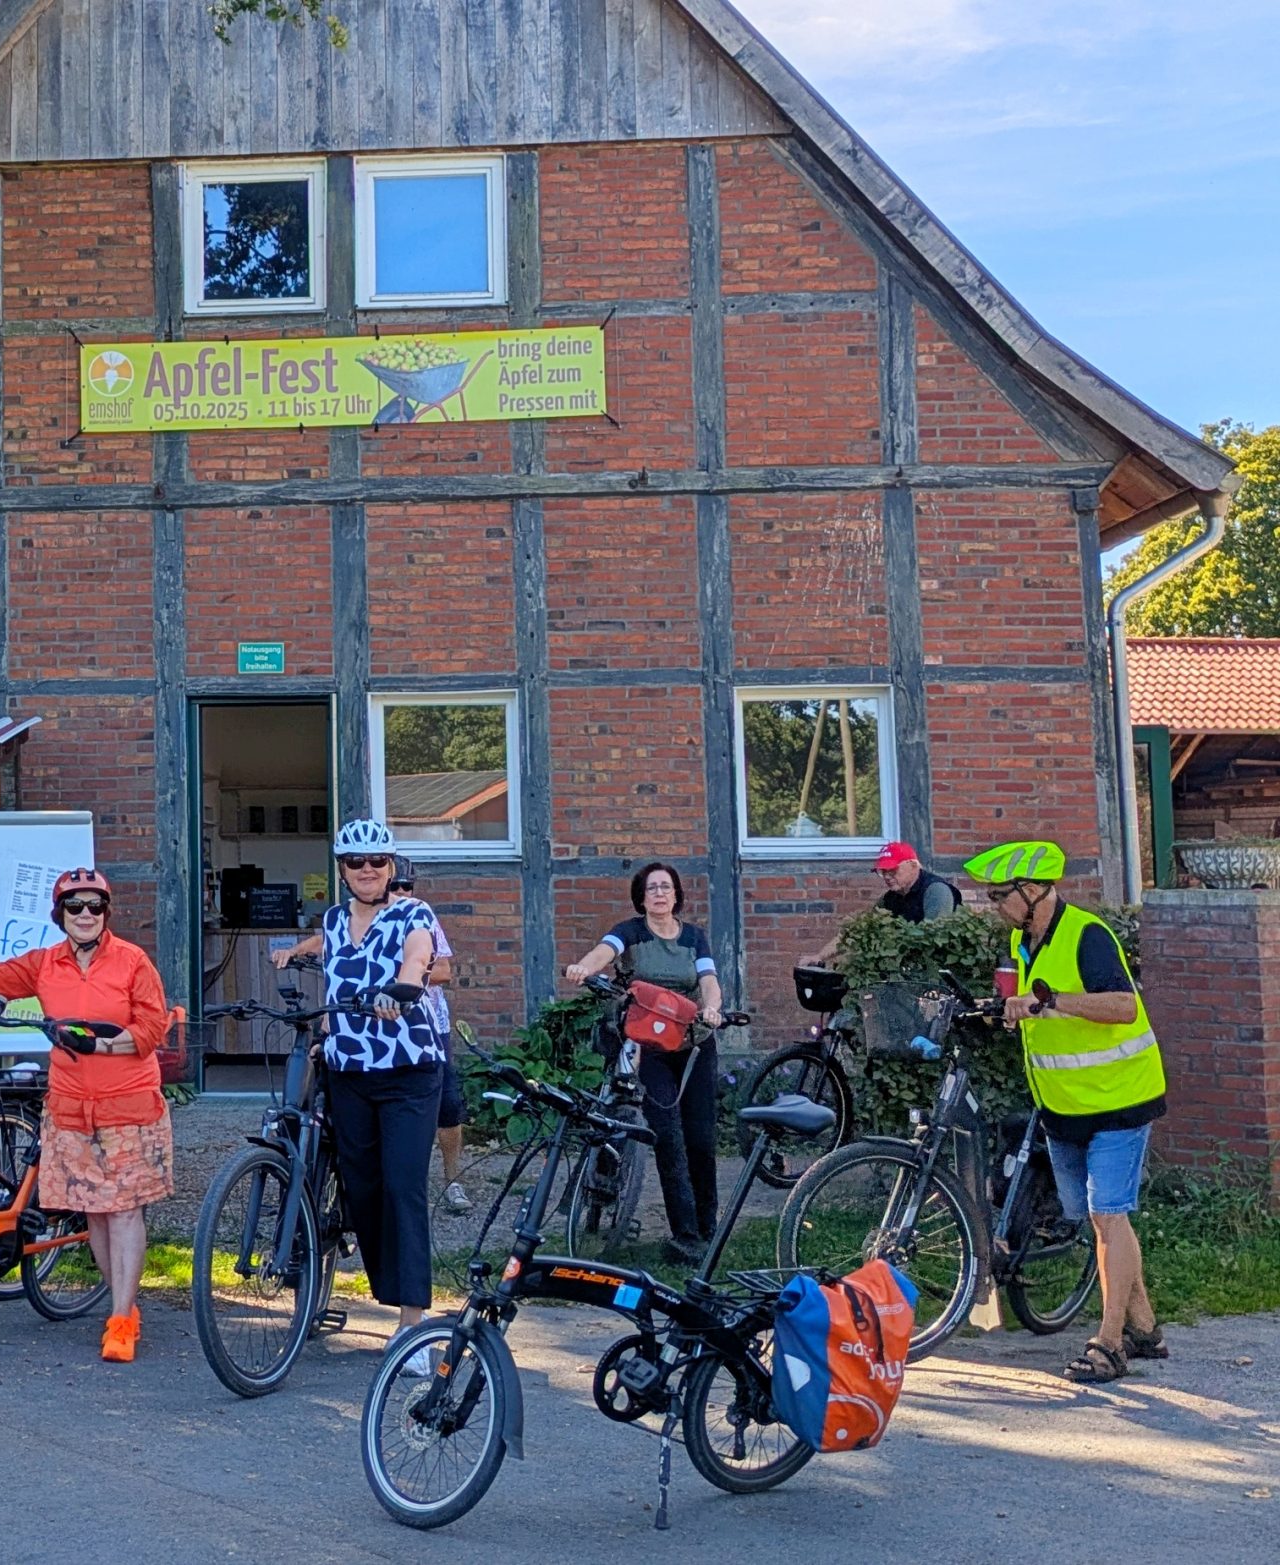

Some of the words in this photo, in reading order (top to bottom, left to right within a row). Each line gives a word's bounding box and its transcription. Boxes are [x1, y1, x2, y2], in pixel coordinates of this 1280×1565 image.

[498, 337, 541, 361] bring
[547, 335, 592, 356] deine
[143, 347, 338, 410] Apfel-Fest
[499, 361, 542, 390] Äpfel
[547, 367, 581, 384] zum
[89, 397, 134, 418] emshof
[154, 401, 248, 423] 05.10.2025
[268, 400, 286, 418] 11
[293, 397, 316, 417] bis
[321, 399, 340, 418] 17
[345, 394, 372, 415] Uhr
[499, 393, 564, 412] Pressen
[569, 389, 597, 410] mit
[241, 646, 281, 654] Notausgang
[246, 662, 277, 670] freihalten
